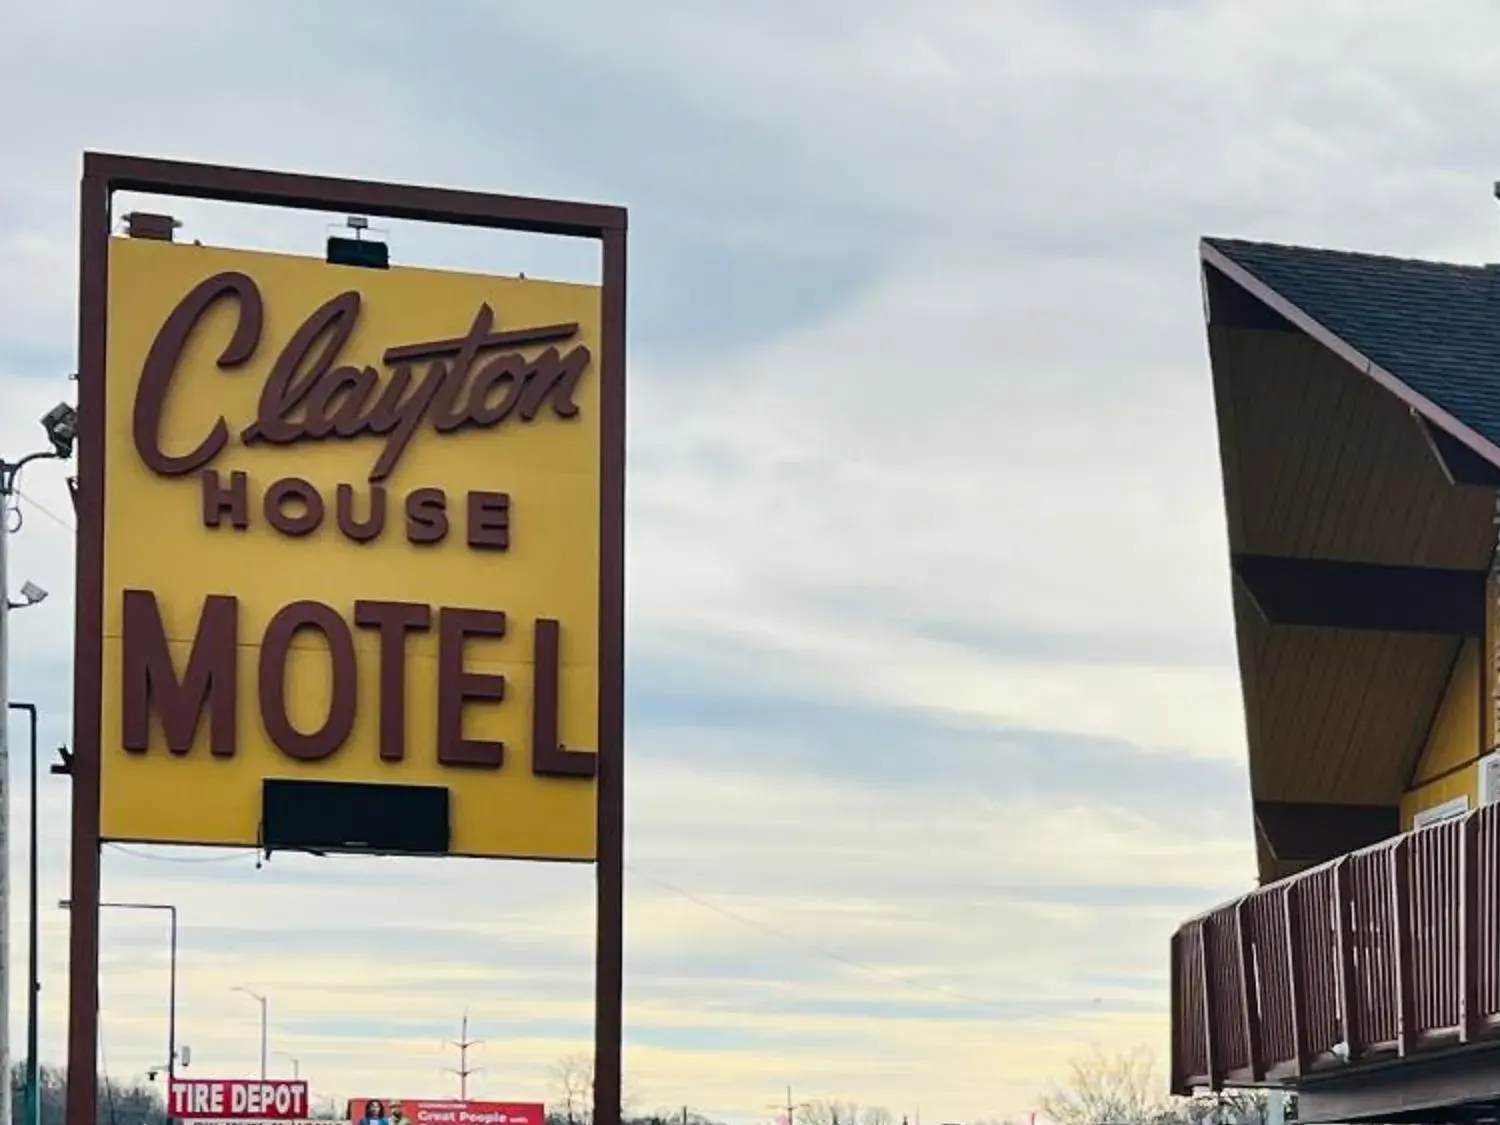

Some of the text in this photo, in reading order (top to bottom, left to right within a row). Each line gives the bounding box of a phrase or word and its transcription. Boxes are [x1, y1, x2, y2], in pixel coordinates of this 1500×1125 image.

[132, 271, 591, 481] Clayton
[200, 468, 511, 551] HOUSE
[120, 588, 597, 778] MOTEL
[172, 1083, 304, 1114] TIRE DEPOT
[417, 1110, 455, 1122] Great
[459, 1112, 507, 1124] People
